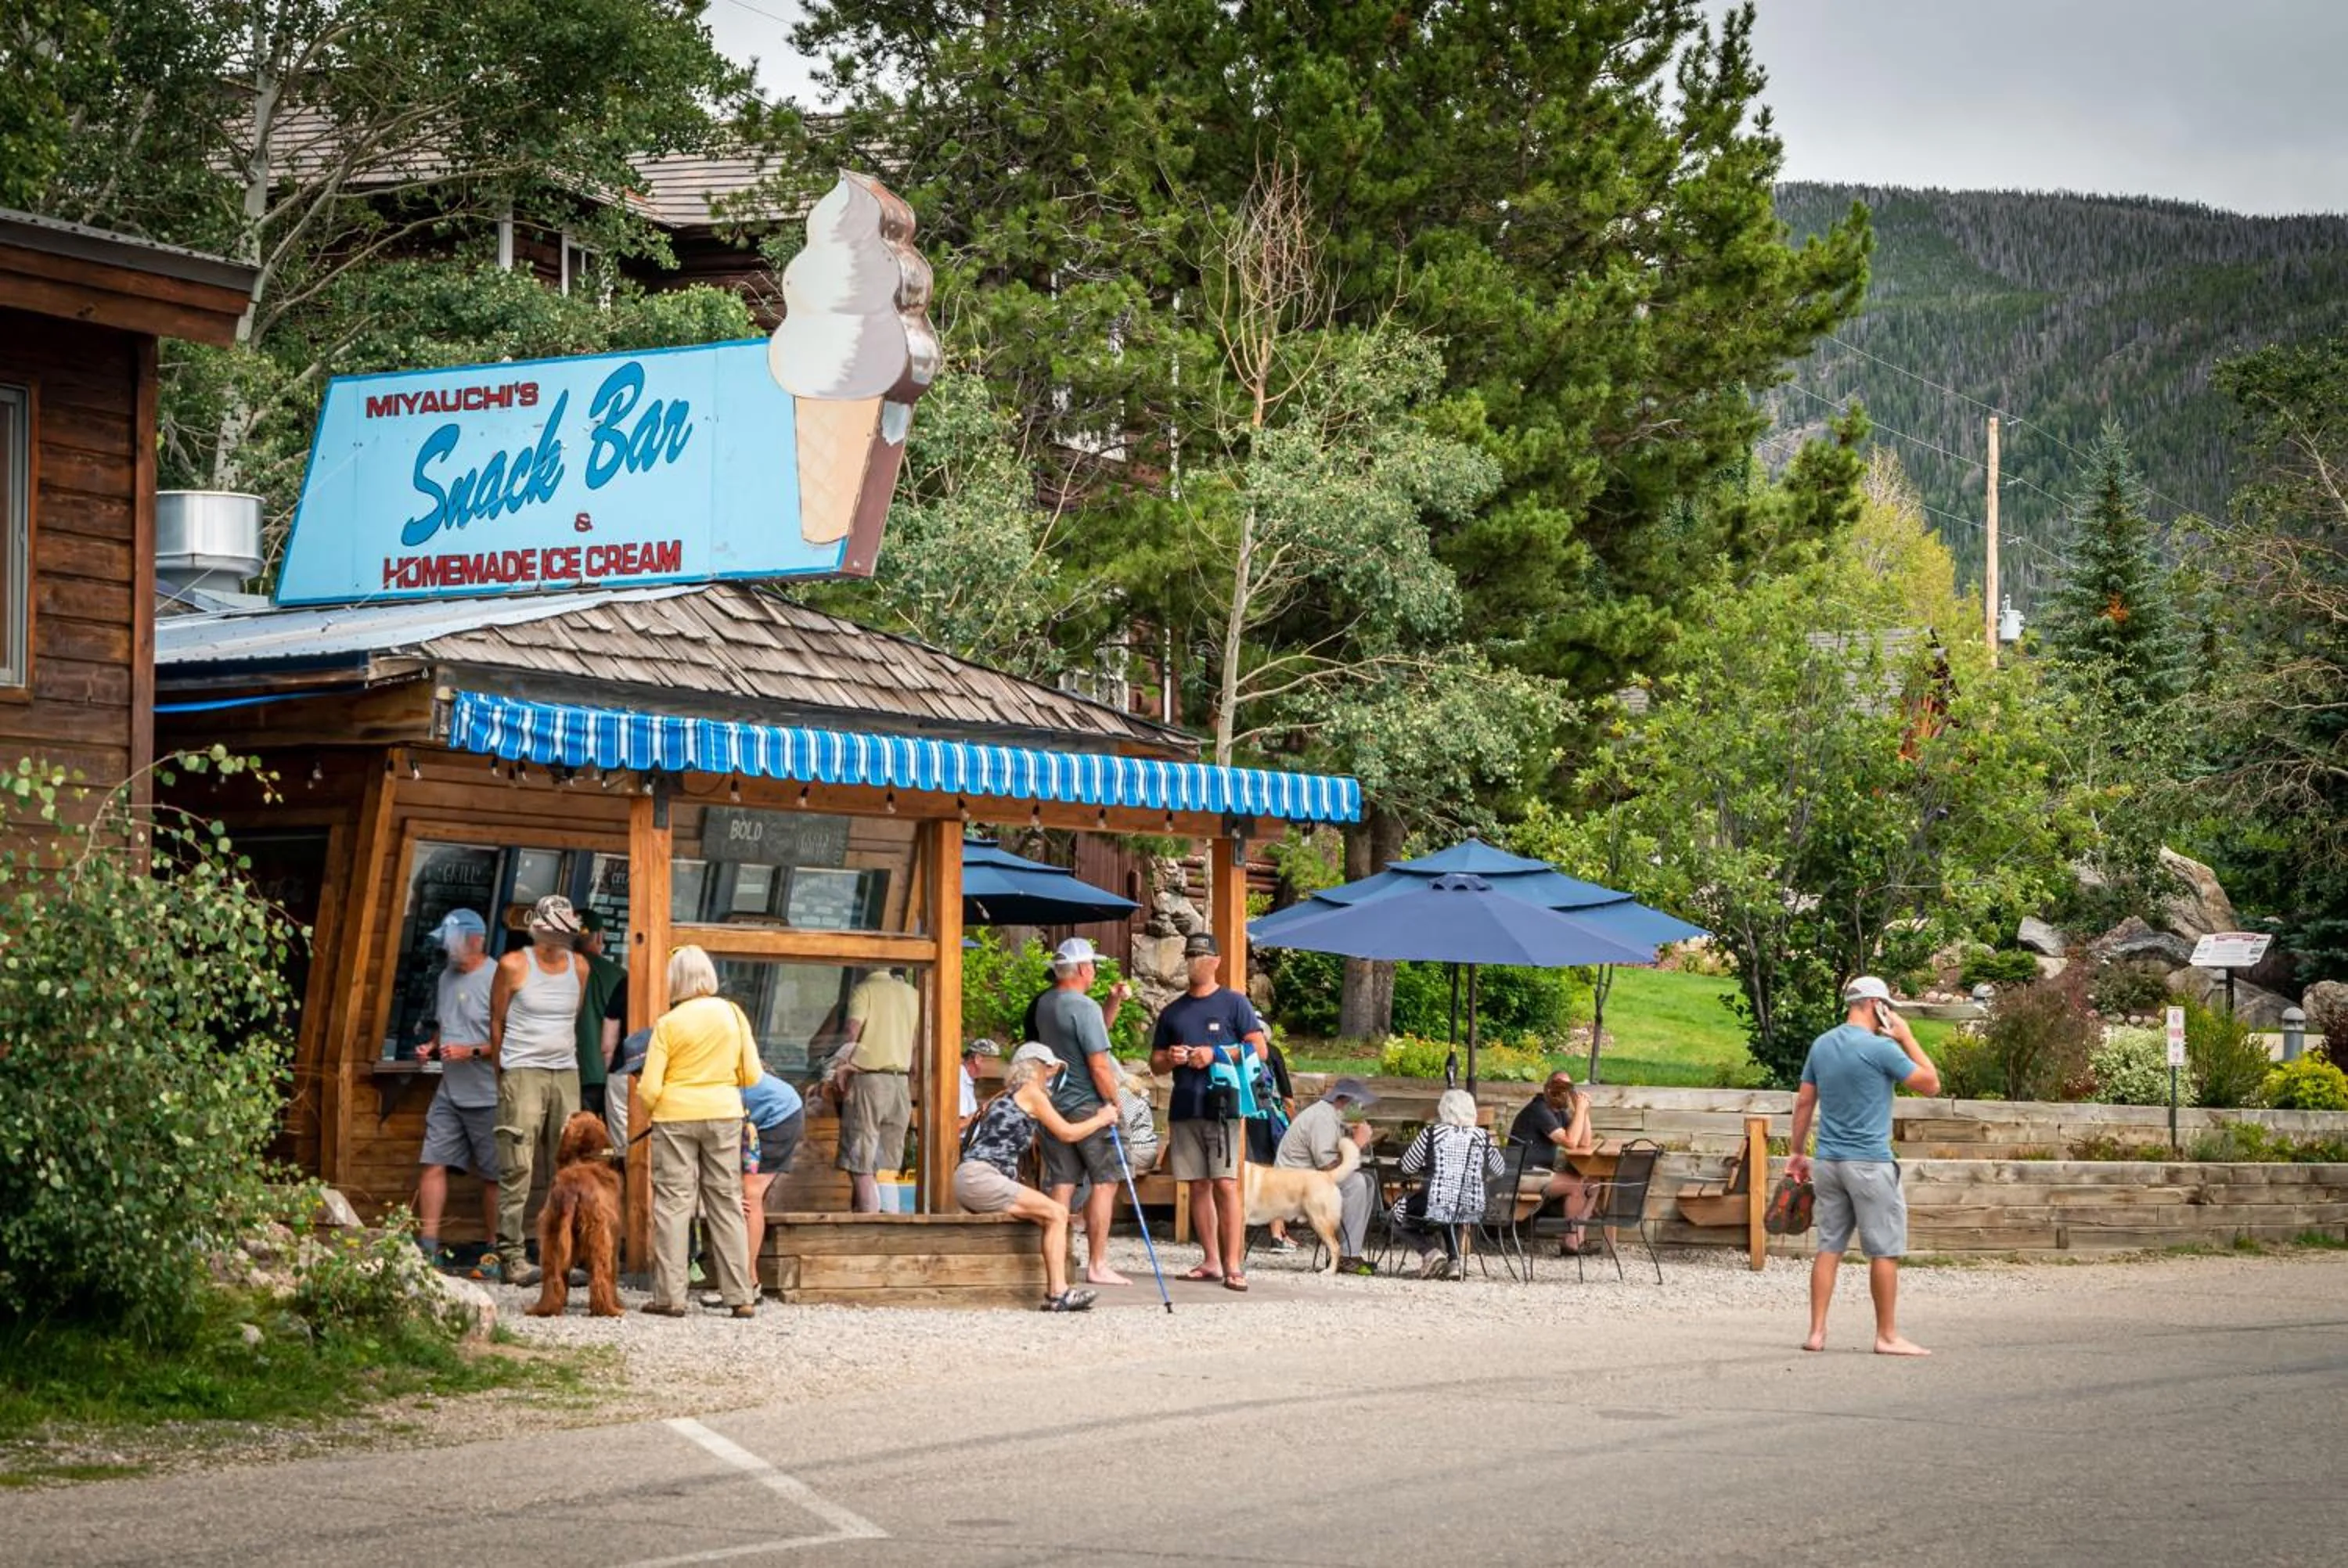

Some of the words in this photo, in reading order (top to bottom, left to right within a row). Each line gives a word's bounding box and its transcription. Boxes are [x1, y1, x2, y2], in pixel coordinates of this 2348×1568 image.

[366, 382, 539, 419] MIYAUCHI'S
[401, 388, 568, 546] Snack
[585, 361, 692, 490] Bar
[574, 512, 593, 533] &
[383, 548, 537, 589] HOMEMADE
[541, 545, 582, 581] ICE
[585, 539, 683, 579] CREAM
